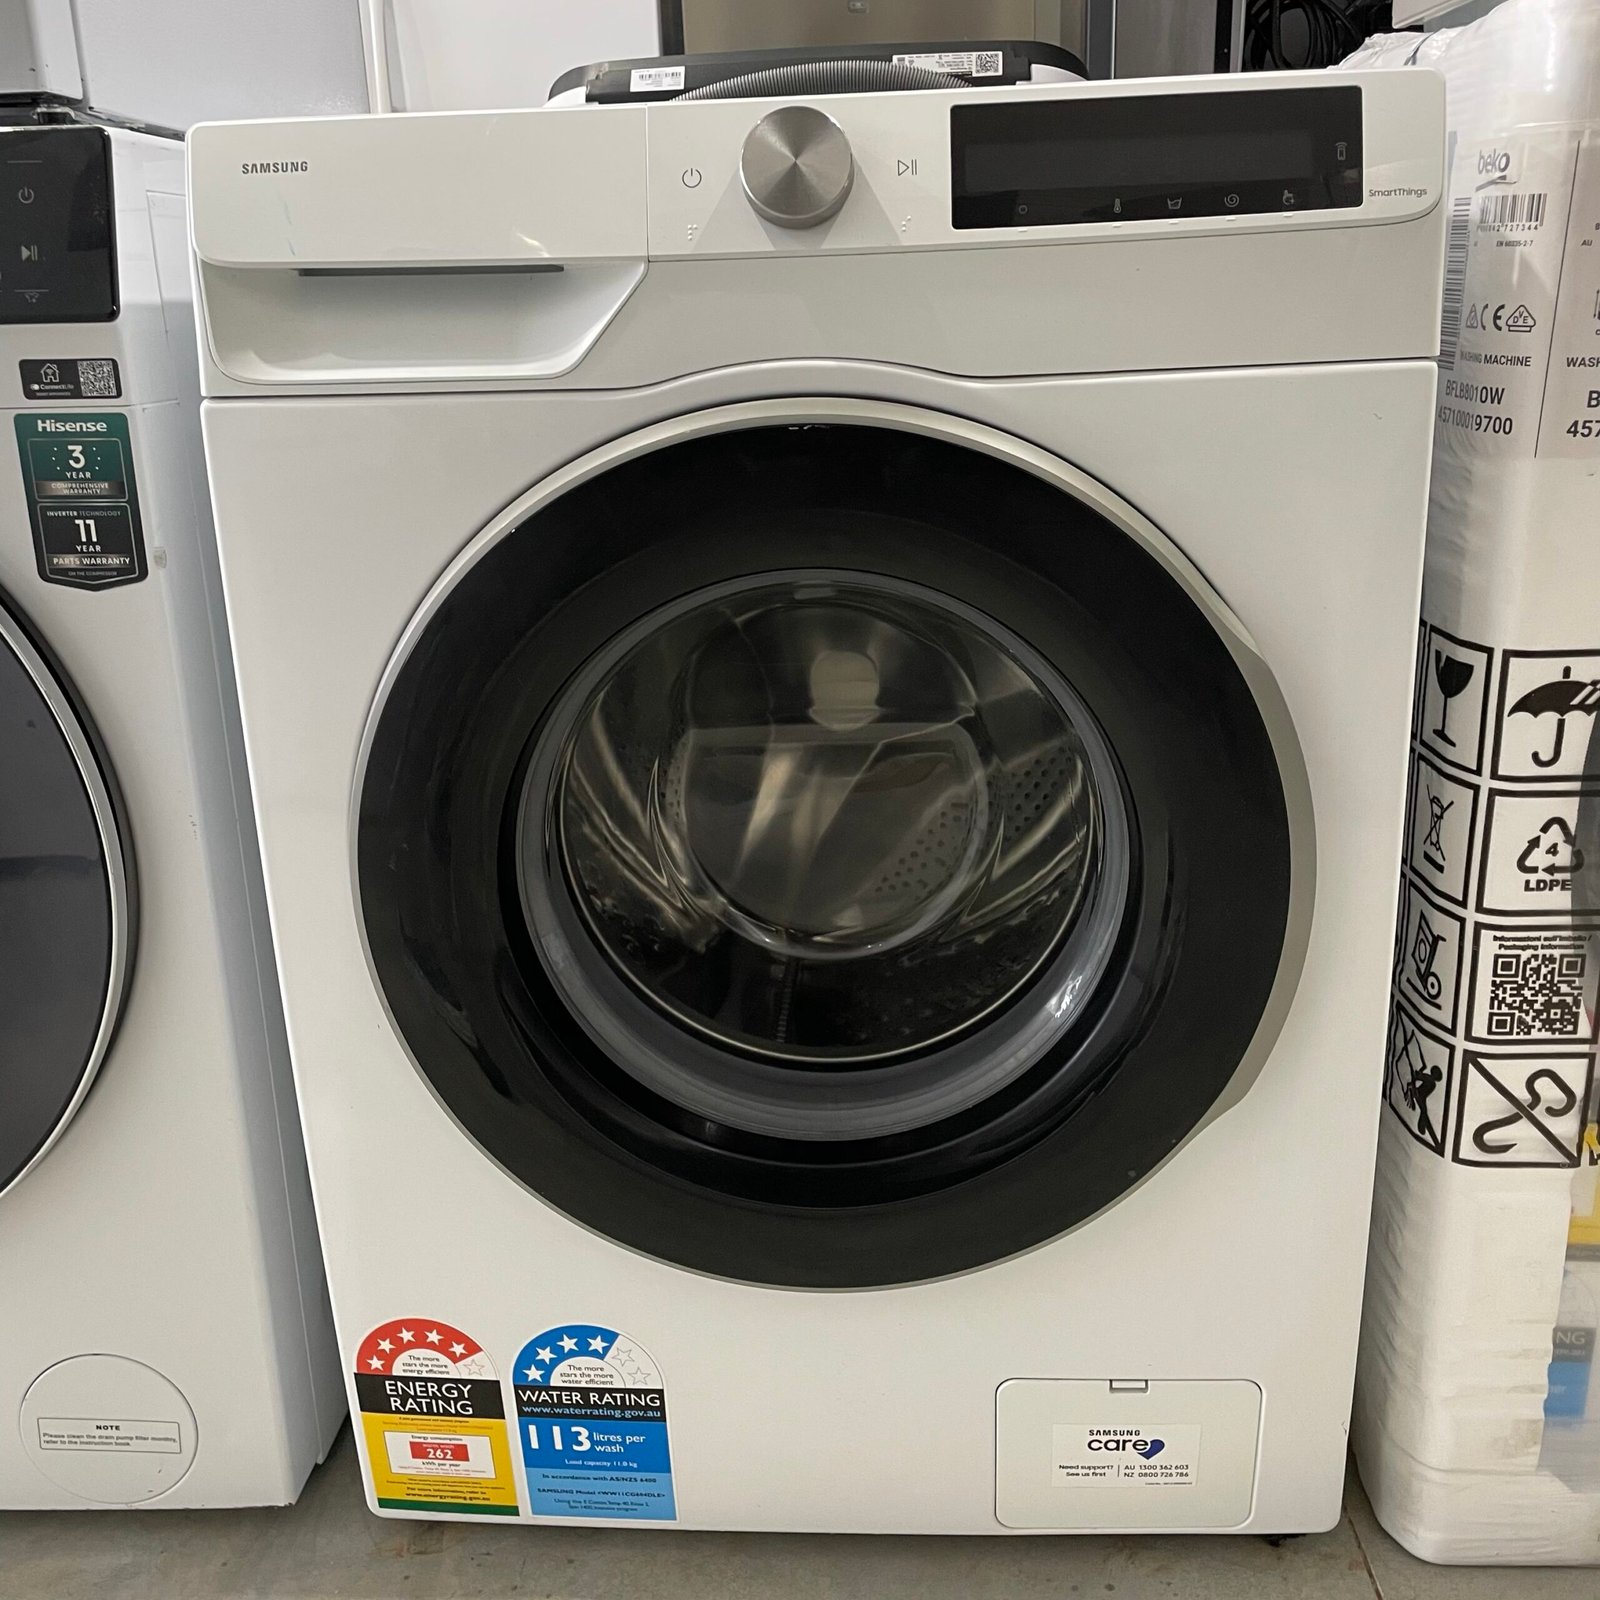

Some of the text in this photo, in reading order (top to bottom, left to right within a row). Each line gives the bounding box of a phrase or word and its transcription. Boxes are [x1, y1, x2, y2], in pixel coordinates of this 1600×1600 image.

[242, 161, 308, 174] SAMSUNG
[1478, 148, 1510, 174] beko
[1368, 188, 1428, 198] SmartThings
[1484, 354, 1532, 367] MACHINE
[1446, 380, 1505, 404] BFLB8010W
[37, 420, 108, 432] Hisense
[67, 444, 86, 468] 3
[74, 519, 97, 542] 11
[1545, 842, 1559, 857] 4
[1524, 879, 1572, 892] LDPE
[385, 1380, 472, 1398] ENERGY
[518, 1390, 660, 1406] WATER RATING
[390, 1398, 473, 1414] RATING
[522, 1406, 661, 1418] www.waterrating.gov.au
[593, 1432, 622, 1442] litres
[626, 1435, 646, 1445] per
[1087, 1439, 1149, 1451] care
[426, 1448, 453, 1459] 262
[594, 1444, 624, 1453] wash
